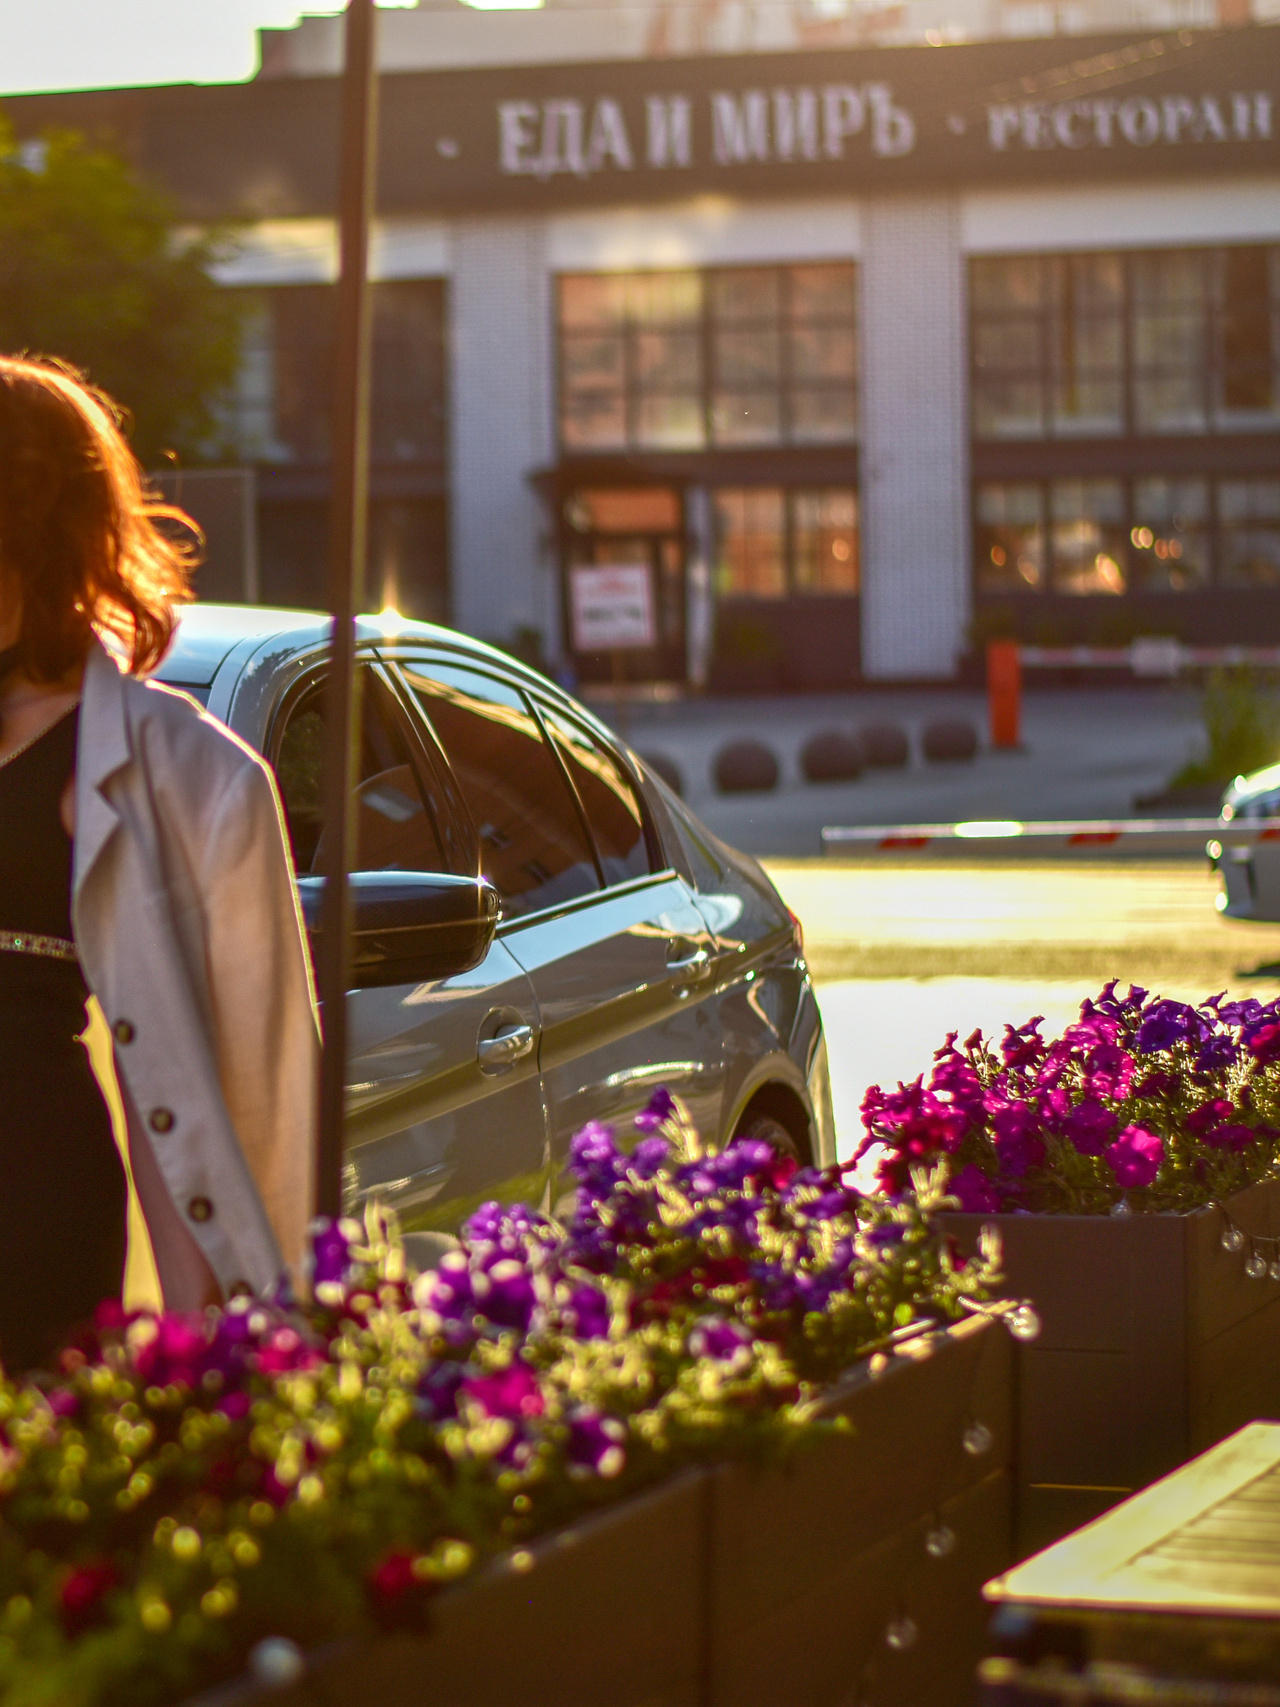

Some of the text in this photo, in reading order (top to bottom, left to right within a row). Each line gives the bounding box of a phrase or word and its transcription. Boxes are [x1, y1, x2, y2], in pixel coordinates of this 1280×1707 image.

[499, 81, 1271, 181] ЕДА И МИРЪ РЕСТОРАН
